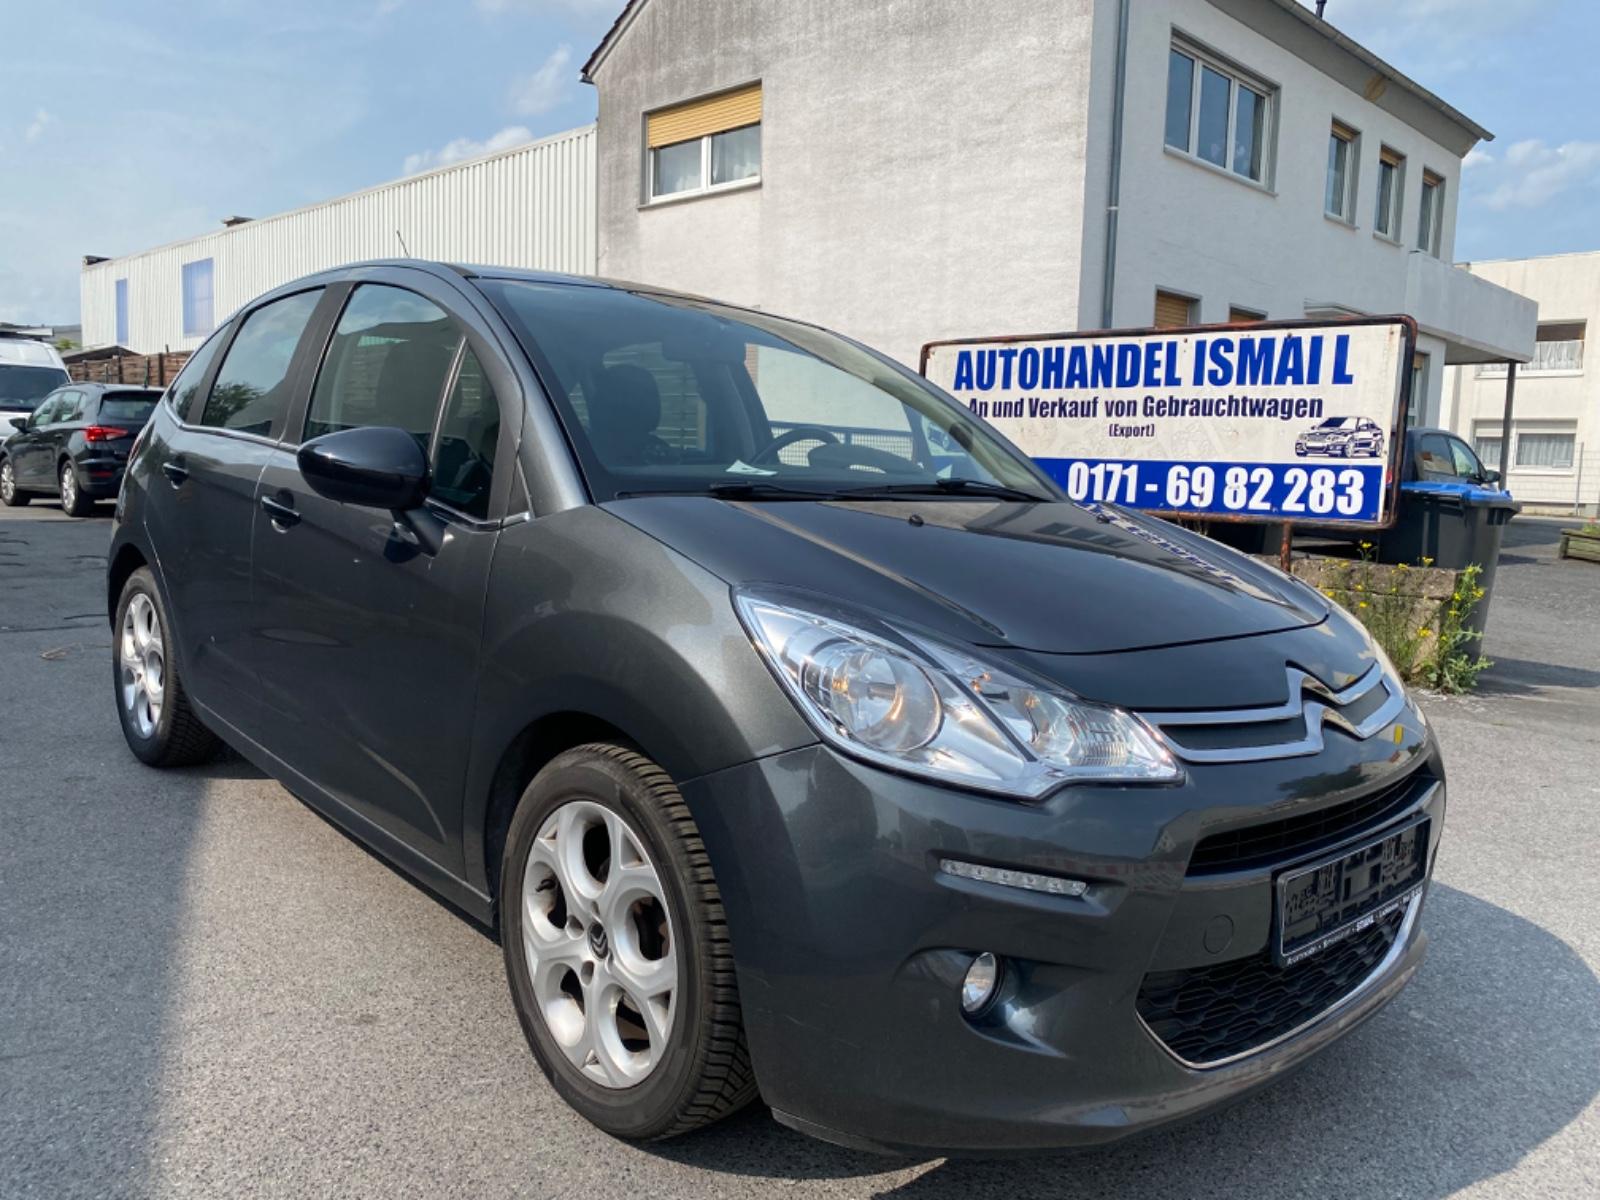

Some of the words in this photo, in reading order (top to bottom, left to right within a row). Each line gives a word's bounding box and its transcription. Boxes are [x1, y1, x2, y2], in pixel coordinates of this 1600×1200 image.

[953, 343, 1182, 391] AUTOHANDEL
[968, 397, 988, 418] An
[992, 397, 1025, 418] und
[1028, 396, 1099, 418] Verkauf
[1105, 399, 1138, 418] von
[1142, 394, 1323, 421] Gebrauchtwagen
[1108, 423, 1155, 438] (Export)
[1068, 461, 1139, 504] 0171
[1166, 464, 1215, 508] 69
[1223, 466, 1274, 511] 82
[1281, 467, 1365, 515] 283
